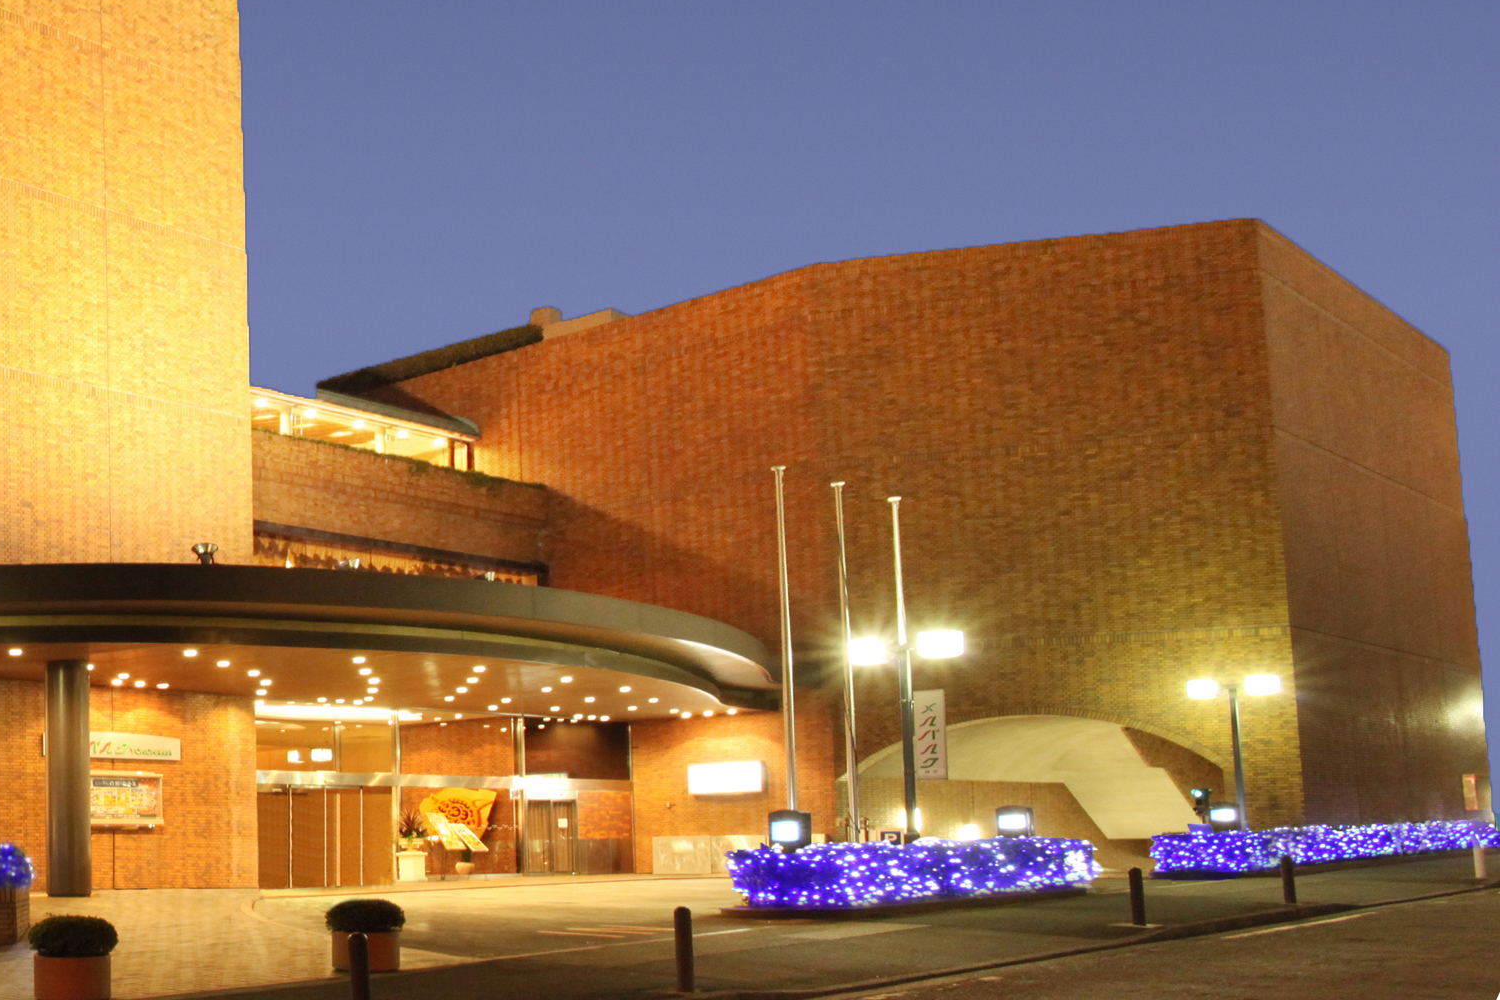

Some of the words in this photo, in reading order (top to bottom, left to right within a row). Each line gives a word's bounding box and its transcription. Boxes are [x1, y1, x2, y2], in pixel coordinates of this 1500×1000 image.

[918, 702, 940, 769] メルパルク
[884, 833, 898, 842] P
